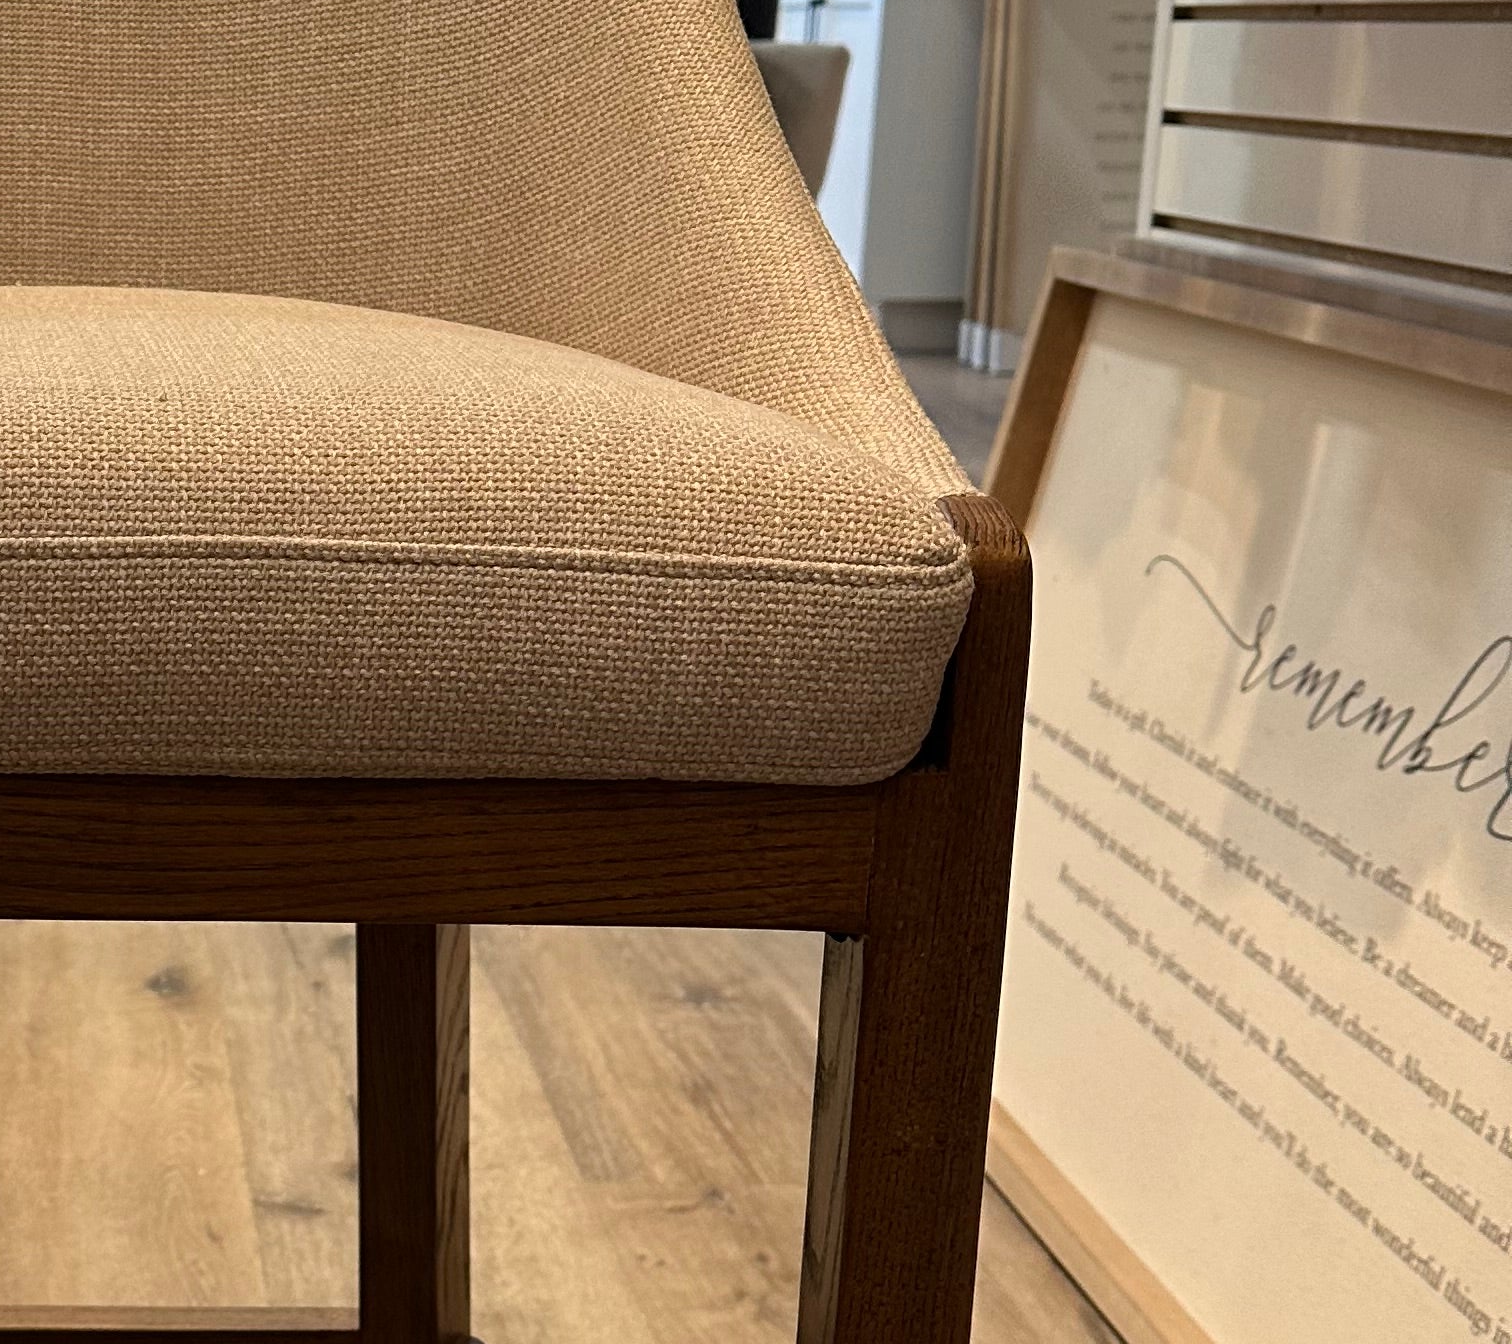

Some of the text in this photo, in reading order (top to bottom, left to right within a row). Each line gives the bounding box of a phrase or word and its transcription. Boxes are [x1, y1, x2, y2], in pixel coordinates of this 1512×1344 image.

[1359, 936, 1385, 971] Be
[1393, 961, 1458, 1021] dreamer
[1453, 1009, 1492, 1044] and
[1415, 889, 1471, 943] Always
[1467, 919, 1510, 971] keep
[1274, 957, 1313, 1004] Make
[1308, 991, 1347, 1030] good
[1395, 1052, 1451, 1110] Always
[1448, 1088, 1490, 1137] lend
[1338, 1102, 1372, 1138] you
[1368, 1125, 1396, 1157] are
[1390, 1143, 1413, 1172] so
[1410, 1151, 1483, 1227] beautiful
[1309, 1161, 1338, 1197] the
[1334, 1185, 1373, 1229] most
[1370, 1216, 1448, 1293] wonderful
[1442, 1276, 1494, 1338] things
